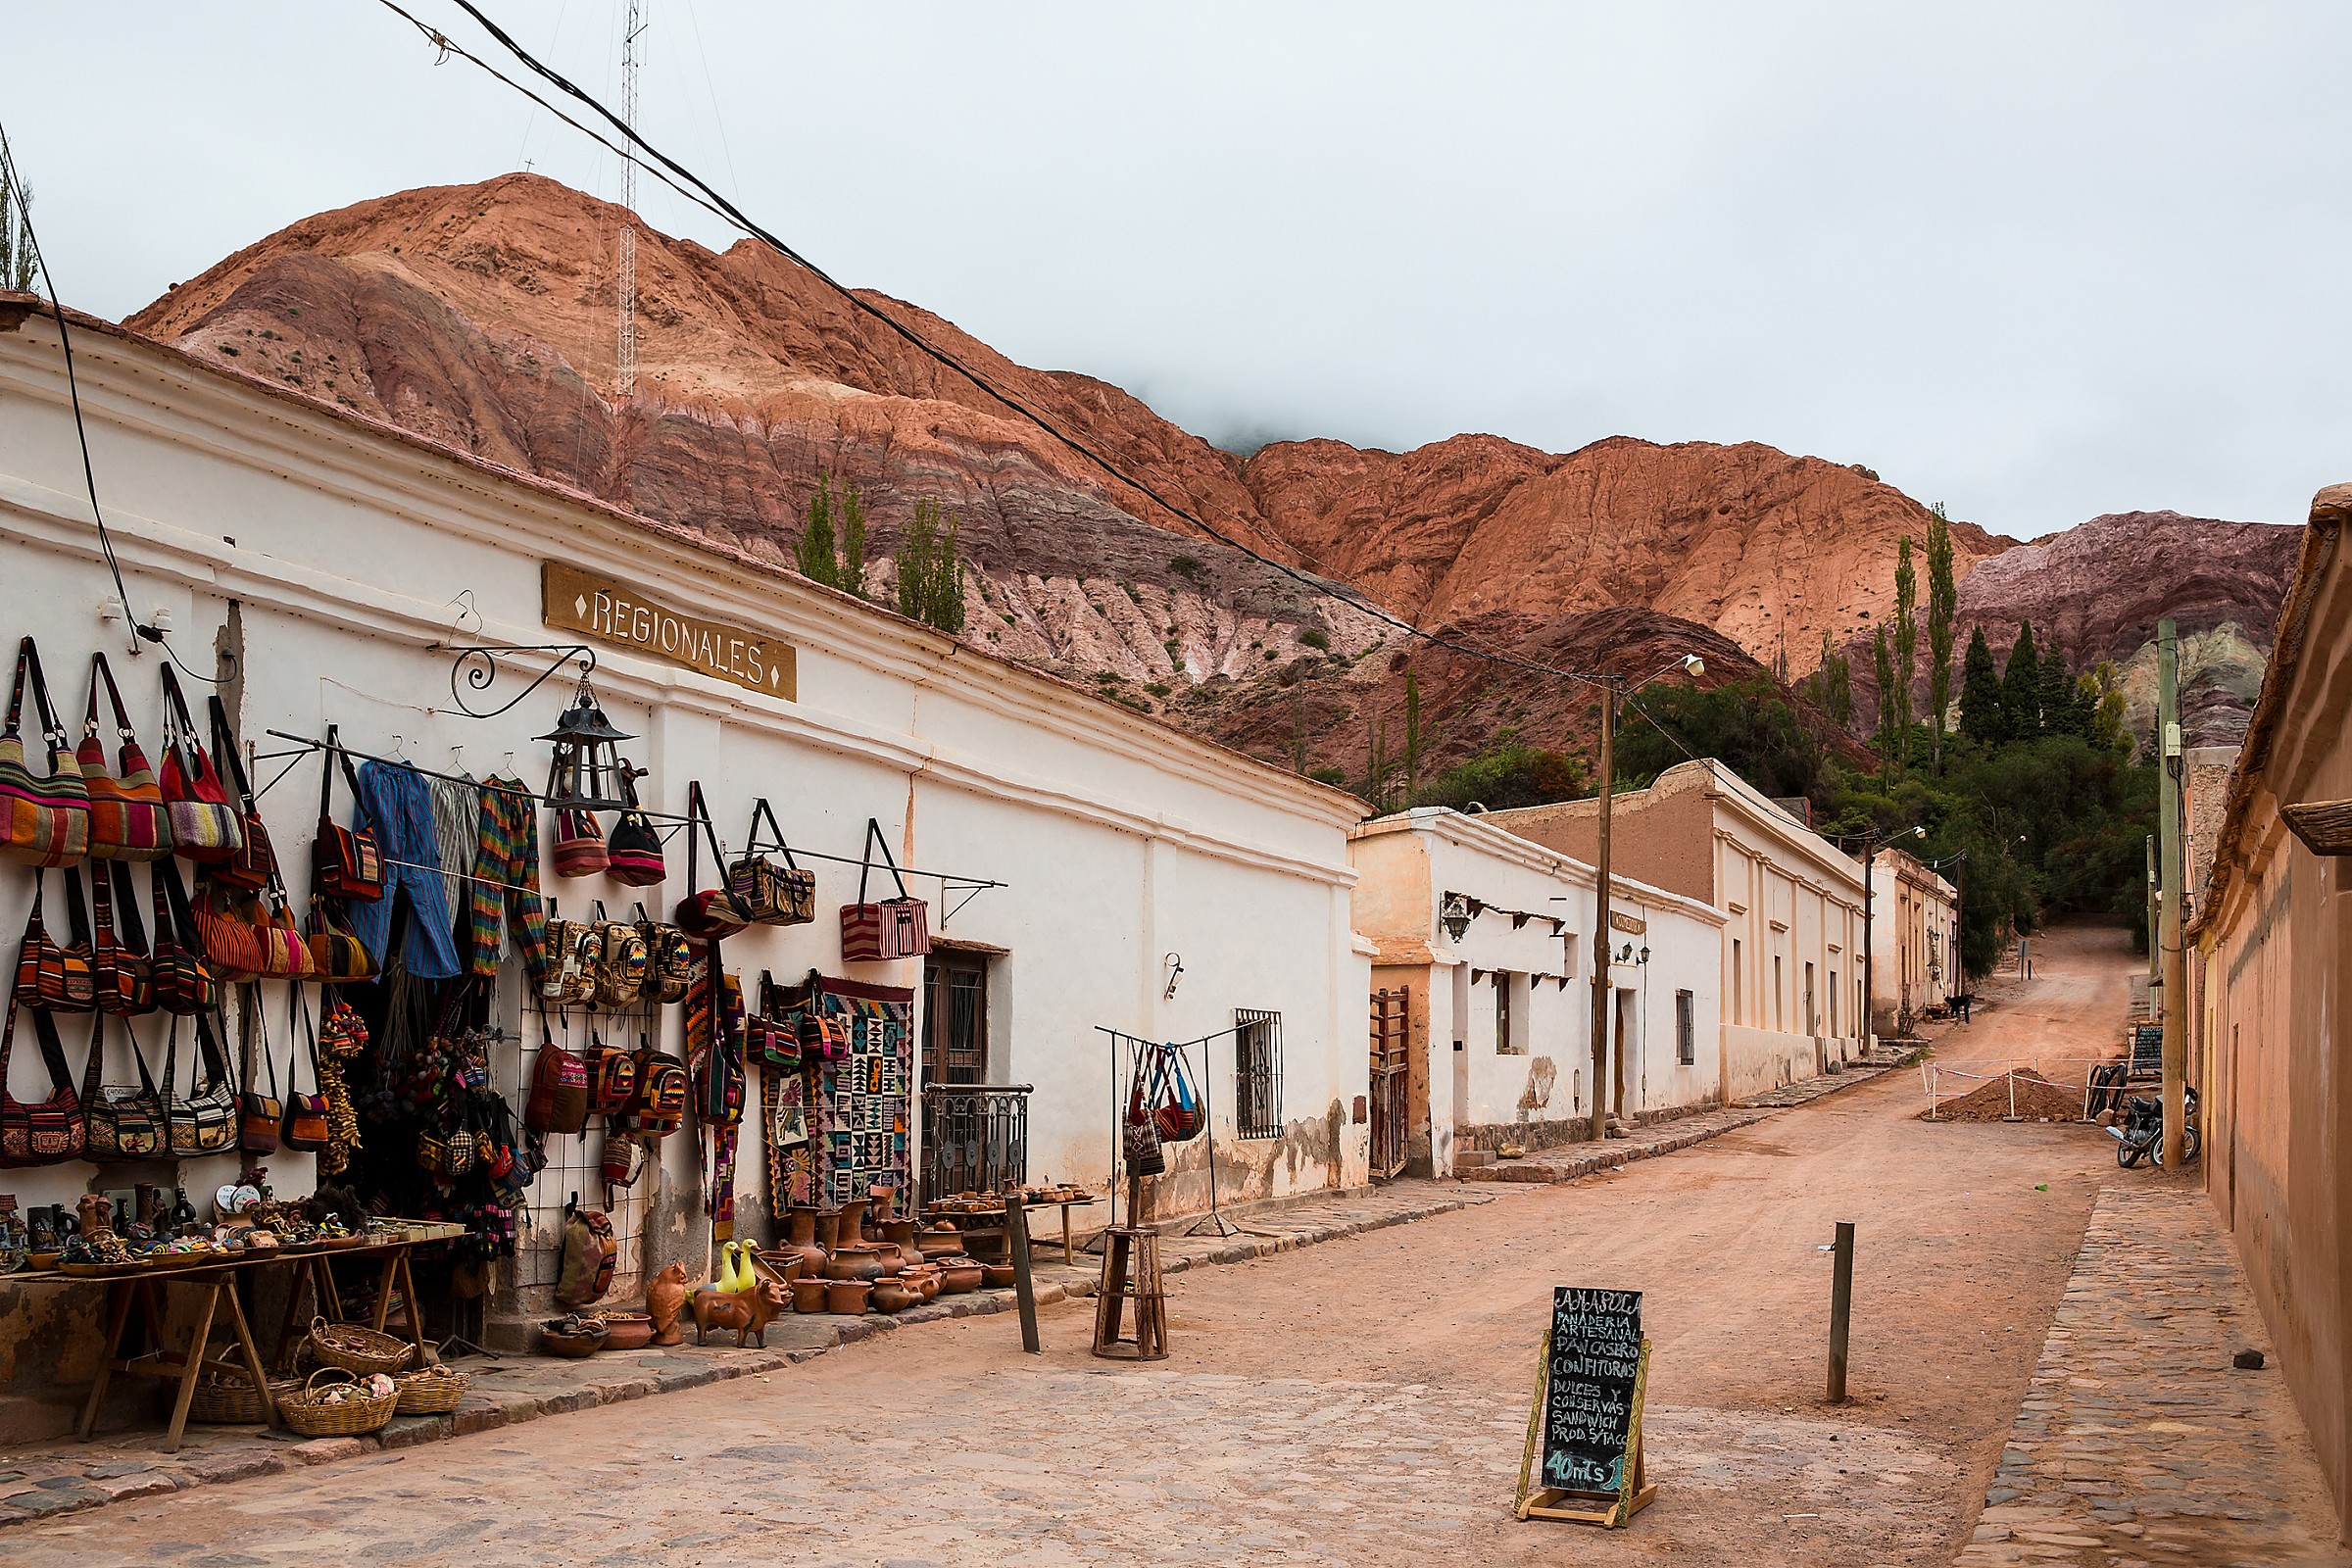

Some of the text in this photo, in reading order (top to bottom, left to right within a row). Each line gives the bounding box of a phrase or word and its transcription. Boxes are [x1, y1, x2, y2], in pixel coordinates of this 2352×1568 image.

[592, 590, 764, 684] REGIONALES
[1556, 1311, 1630, 1329] PANADERIA
[1556, 1324, 1640, 1343] ARTESANAL
[1556, 1336, 1639, 1358] PAN CASERO
[1553, 1354, 1636, 1378] CONFITURAS
[1553, 1379, 1621, 1401] DULCES Y
[1552, 1395, 1624, 1415] CONSERVAS
[1551, 1409, 1618, 1430] SANDWICH
[1551, 1424, 1588, 1443] PROD.
